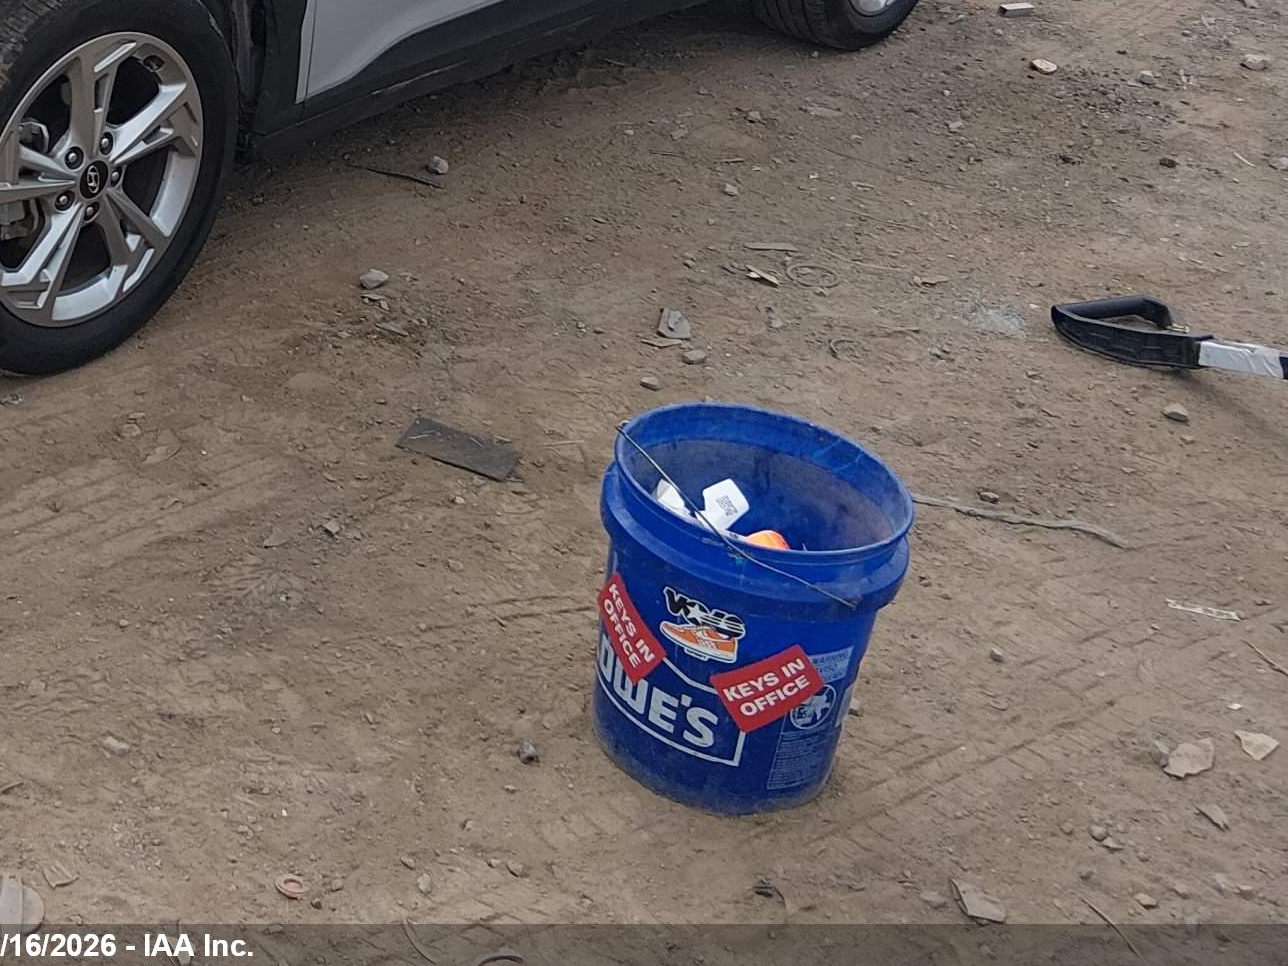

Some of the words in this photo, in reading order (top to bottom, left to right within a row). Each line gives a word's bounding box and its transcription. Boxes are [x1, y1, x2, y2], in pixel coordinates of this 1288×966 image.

[604, 598, 642, 668] OFFICE
[608, 583, 637, 637] KEYS
[635, 638, 655, 663] IN
[599, 633, 719, 748] OWE'S
[722, 672, 780, 702] KEYS
[780, 658, 805, 678] IN
[740, 675, 810, 716] OFFICE
